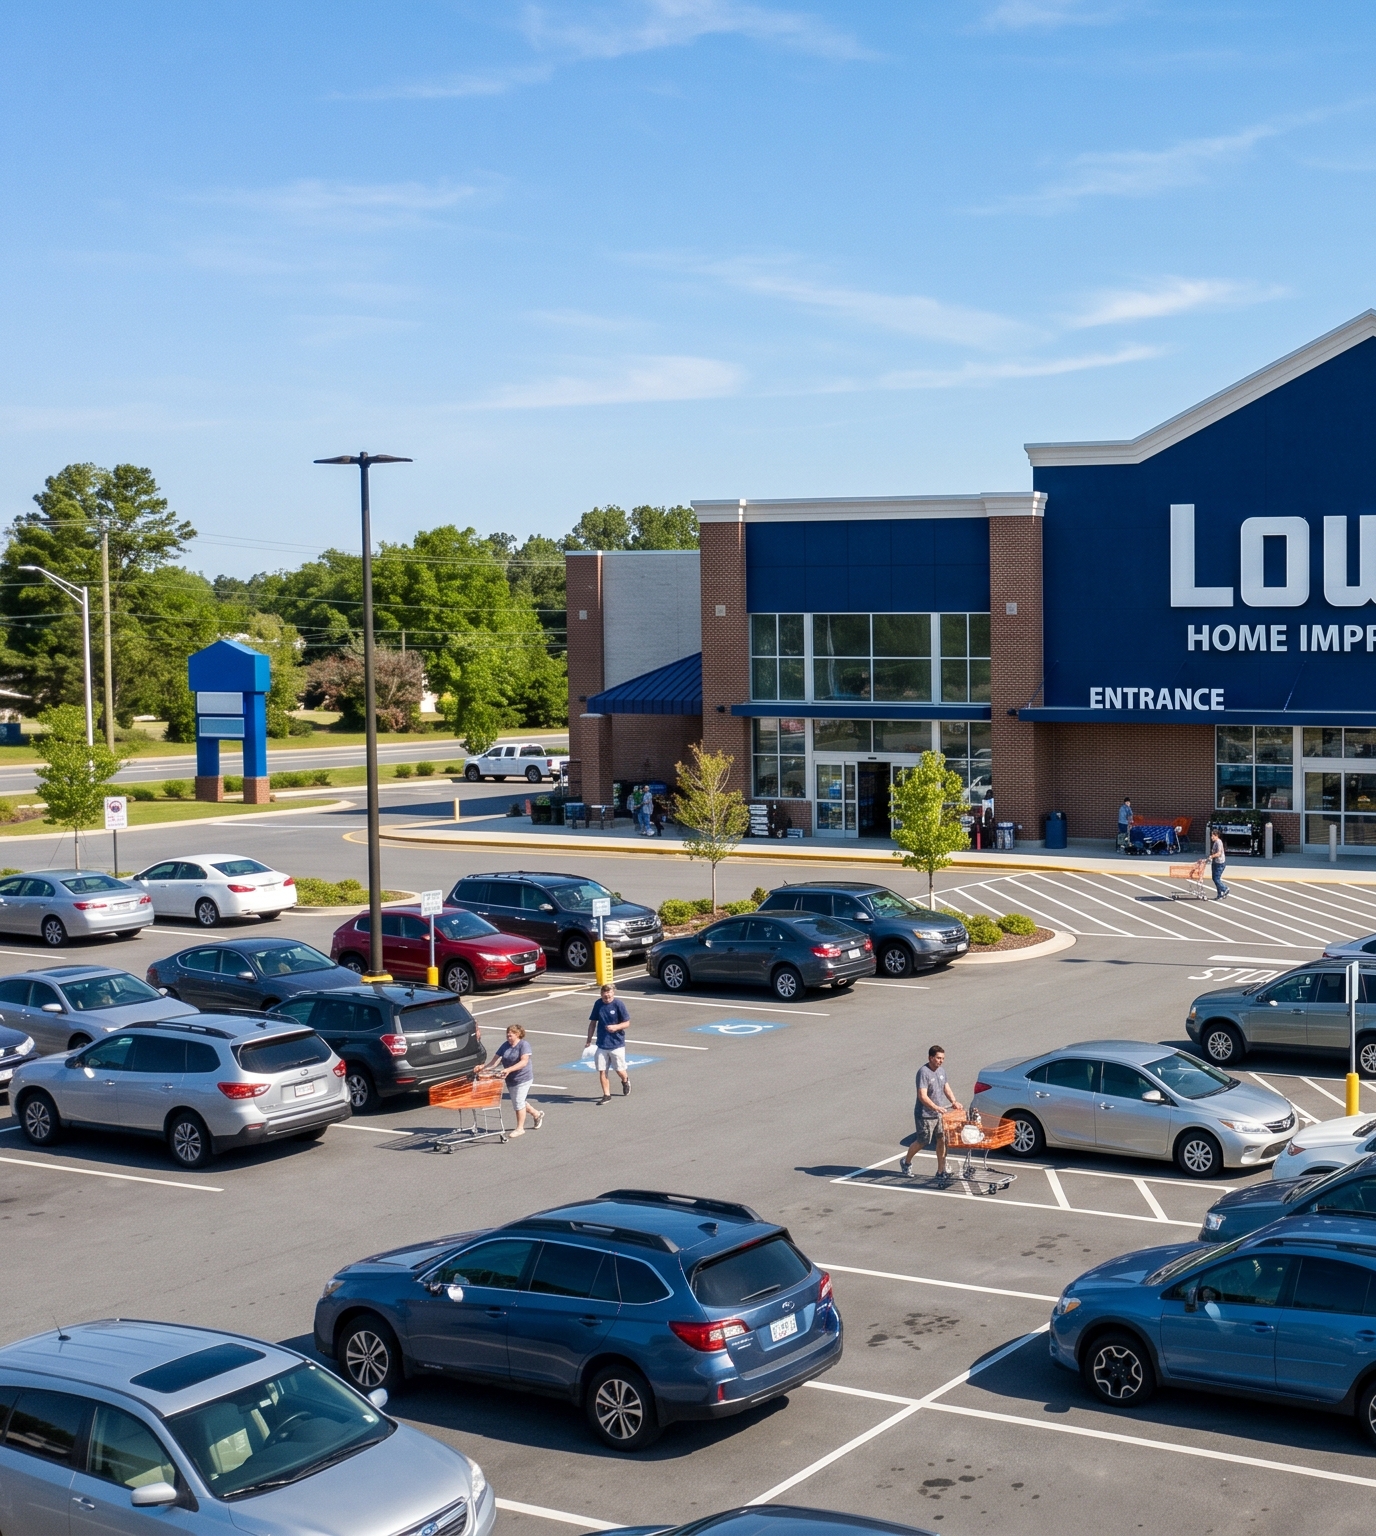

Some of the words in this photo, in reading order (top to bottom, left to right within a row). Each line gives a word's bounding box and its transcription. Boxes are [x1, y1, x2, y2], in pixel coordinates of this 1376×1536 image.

[1187, 624, 1288, 652] HOME
[1089, 687, 1225, 711] ENTRANCE
[1187, 967, 1281, 984] STO
